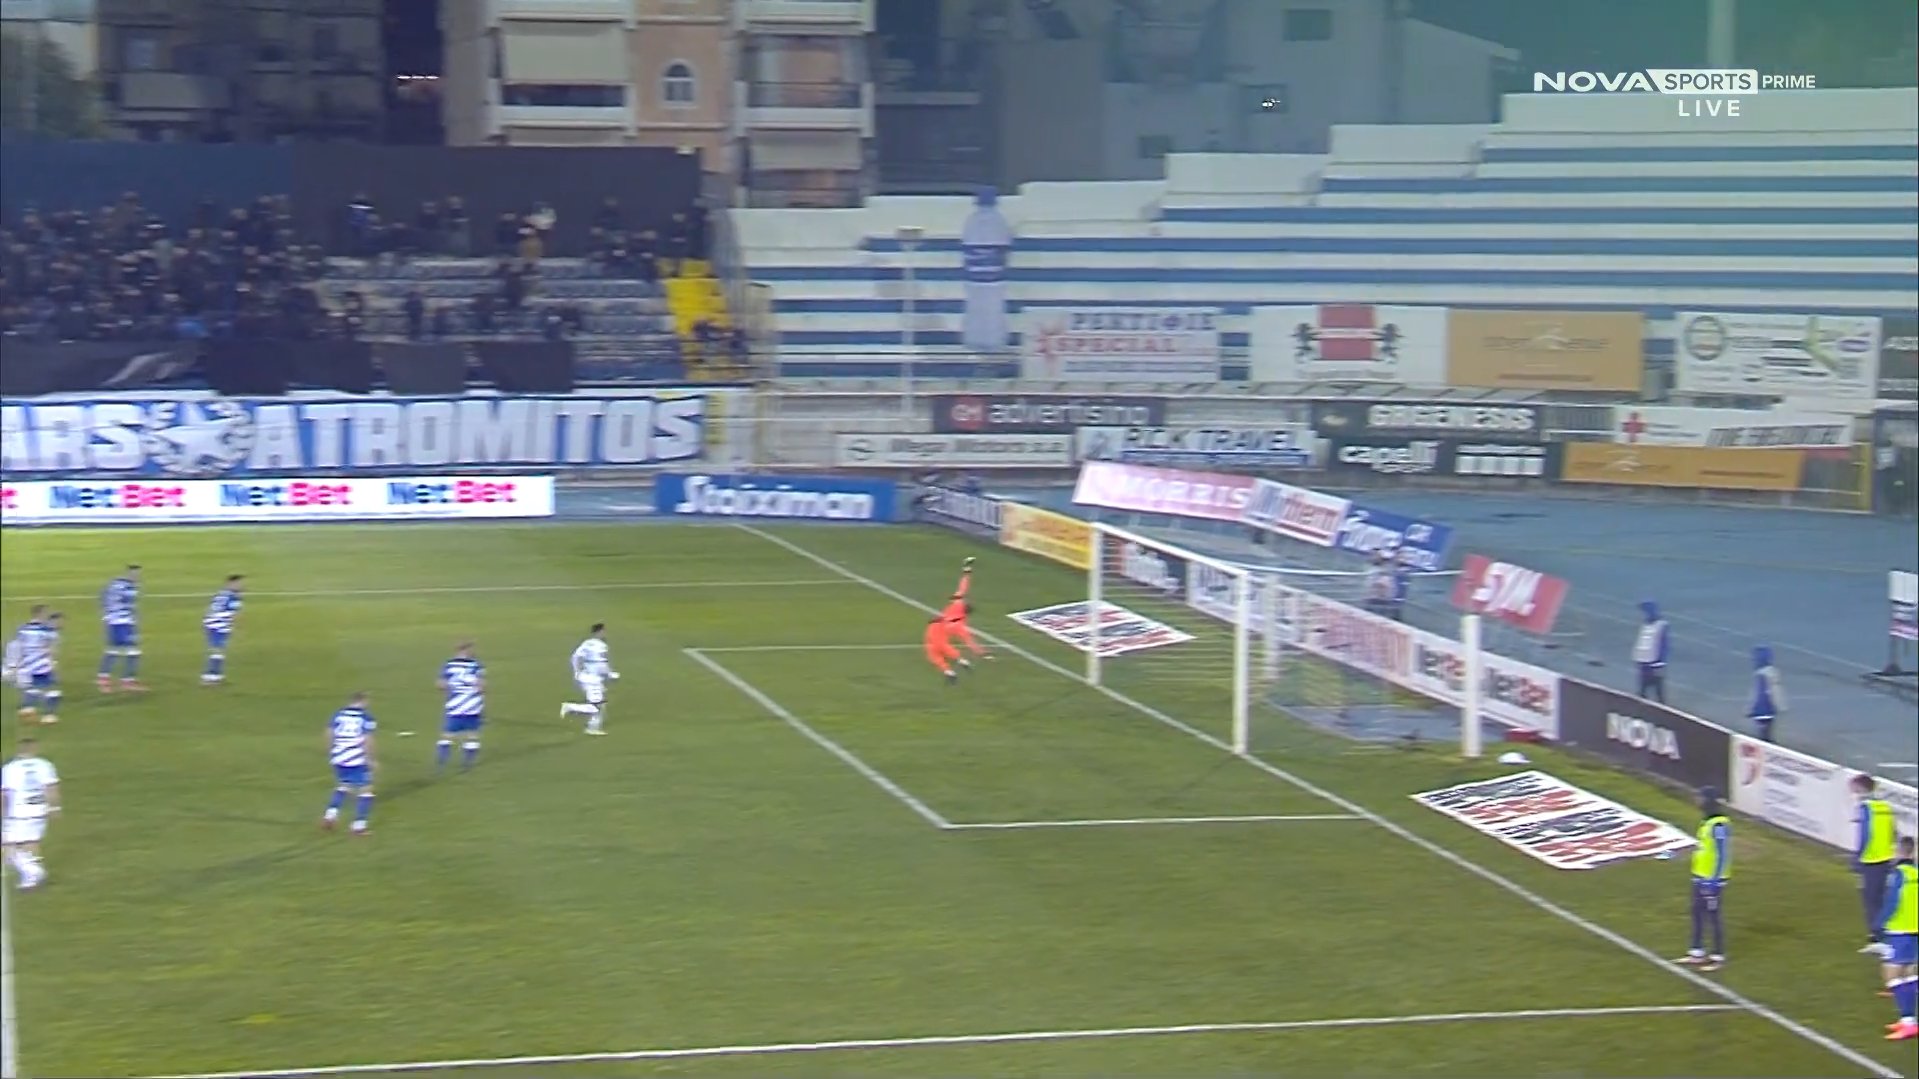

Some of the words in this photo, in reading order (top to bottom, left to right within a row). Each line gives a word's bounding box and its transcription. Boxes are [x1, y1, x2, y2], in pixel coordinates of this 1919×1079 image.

[248, 396, 704, 470] ATROMITOS
[1197, 429, 1304, 451] TRAVEL
[48, 483, 186, 509] NetBet
[219, 481, 352, 507] NetBet
[387, 479, 518, 505] NetBet
[674, 476, 873, 519] Stoiximan
[1606, 711, 1682, 760] NOVA
